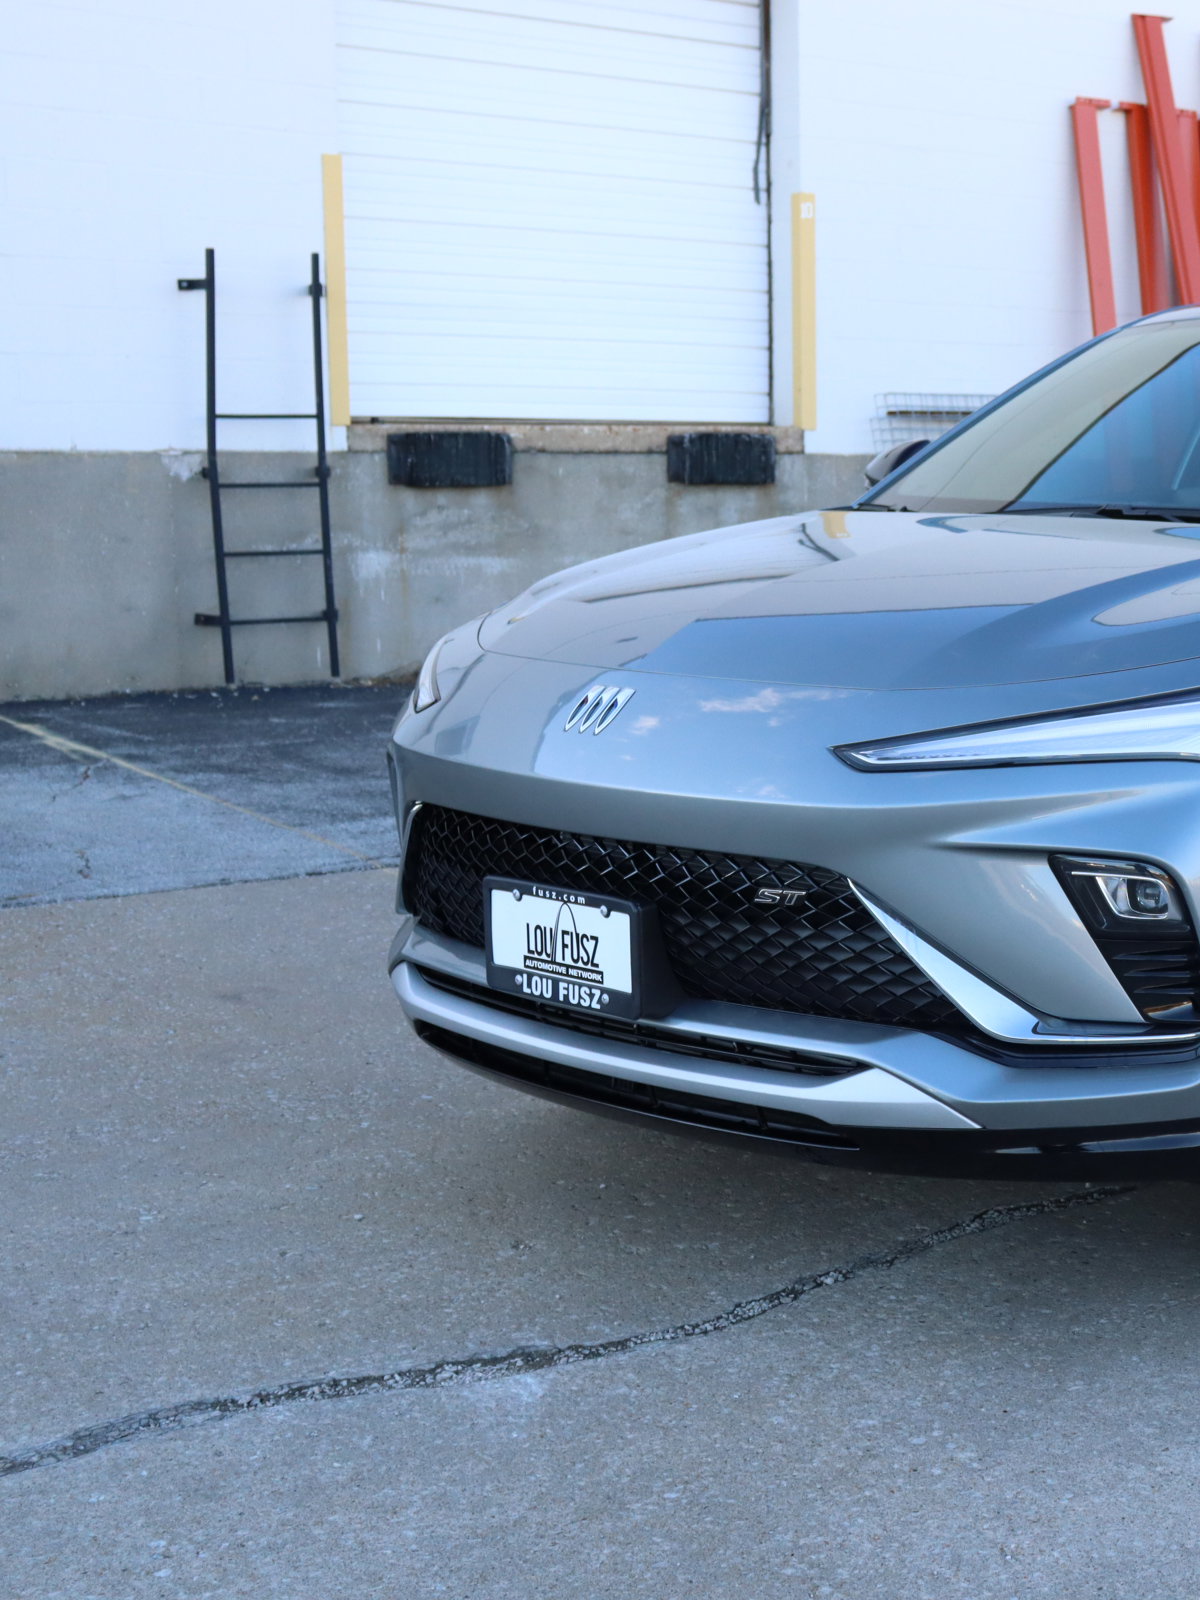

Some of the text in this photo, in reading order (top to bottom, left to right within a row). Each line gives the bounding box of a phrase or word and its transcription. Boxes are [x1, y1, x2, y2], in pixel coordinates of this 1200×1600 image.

[532, 887, 586, 904] fusz.com
[754, 888, 807, 906] ST
[526, 922, 599, 968] LOU FUSZ
[525, 959, 602, 982] AUTOMOTIVE NETWORK
[522, 973, 601, 1009] LOU FUSZ
